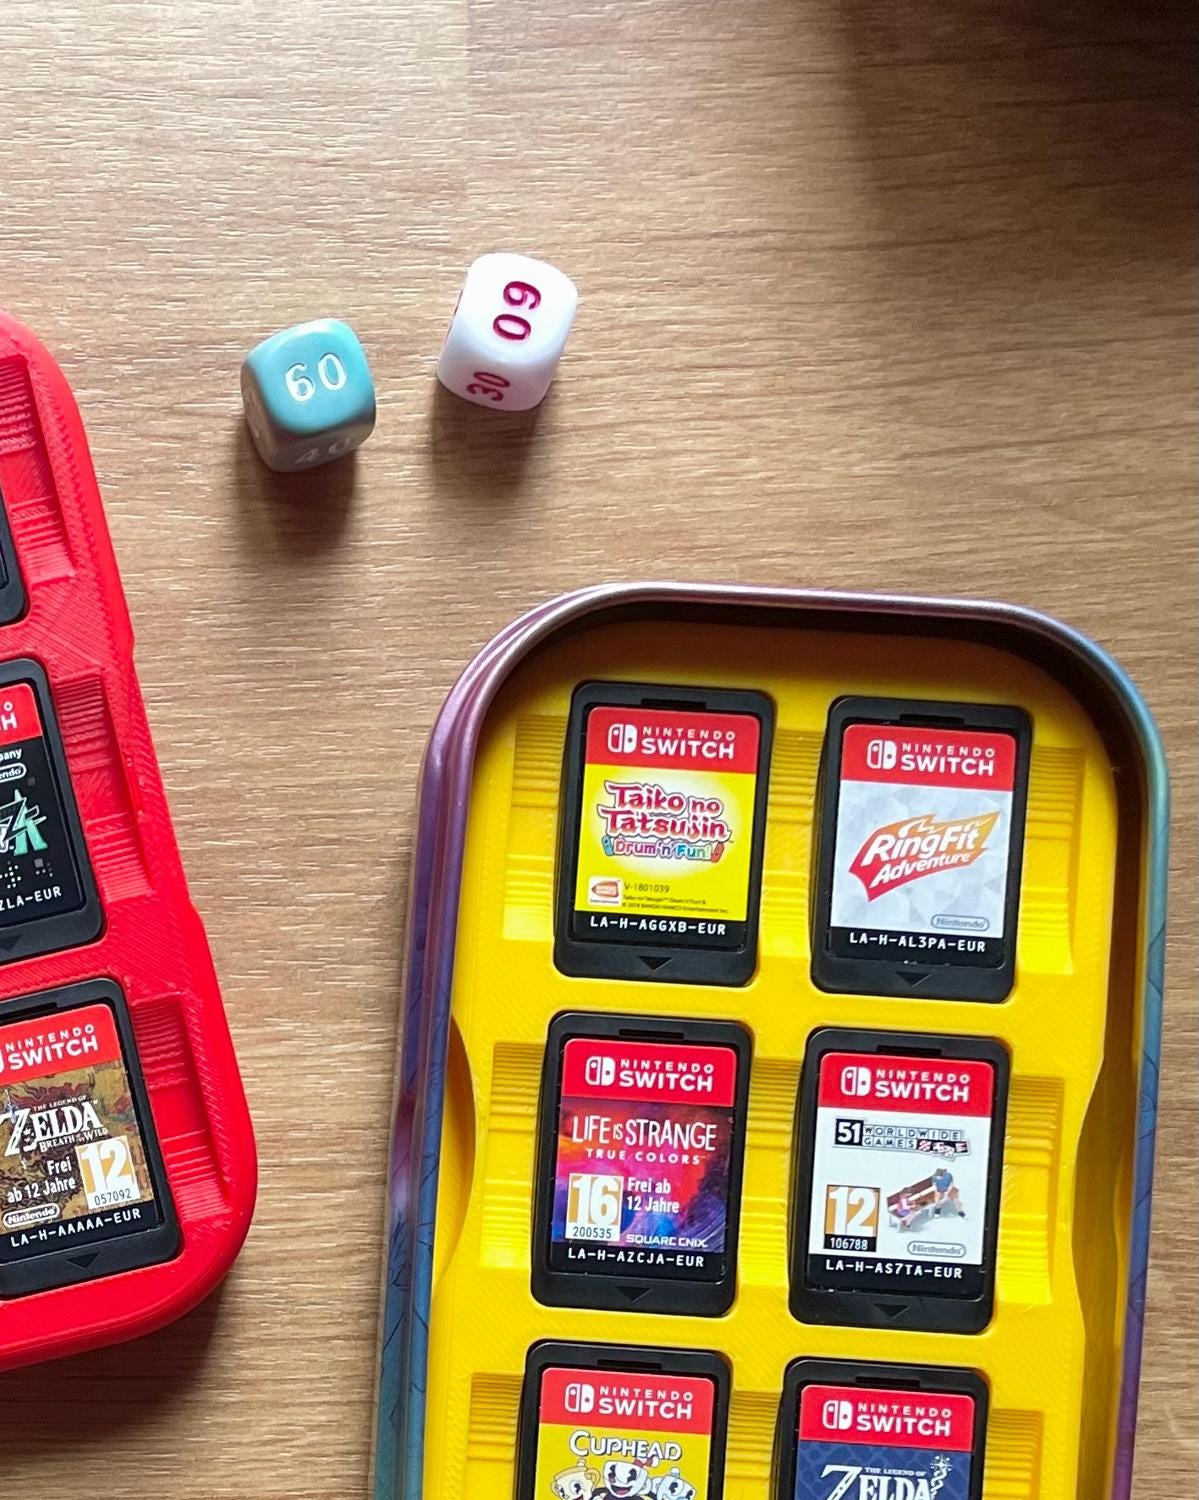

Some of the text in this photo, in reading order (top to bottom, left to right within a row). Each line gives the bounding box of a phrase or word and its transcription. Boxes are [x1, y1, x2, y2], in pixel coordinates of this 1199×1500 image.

[493, 281, 542, 342] 60
[284, 352, 348, 402] 60
[467, 371, 511, 401] 30
[643, 726, 736, 741] NINTENDO
[642, 738, 734, 759] SWITCH
[903, 743, 995, 758] NINTENDO
[901, 755, 994, 777] SWITCH
[606, 781, 721, 814] Taiko no
[599, 807, 729, 841] Tatsujin
[869, 852, 972, 888] Adventure
[624, 883, 670, 893] V-1801039
[590, 916, 726, 935] LA-H-AGGXB-EUR
[849, 931, 986, 952] LA-H-AL3PA-EUR
[6, 1024, 94, 1051] NINTENDO
[8, 1036, 98, 1069] SWITCH
[620, 1059, 714, 1073] NINTENDO
[876, 1069, 970, 1084] NINTENDO
[619, 1071, 712, 1092] SWITCH
[876, 1081, 968, 1102] SWITCH
[84, 1128, 108, 1141] WILD
[572, 1116, 717, 1150] LIFE IS STRANGE
[837, 1122, 961, 1144] 51 WORLDWIDE
[863, 1137, 915, 1148] GAMES
[47, 1156, 72, 1175] Frei
[586, 1148, 700, 1165] TRUE COLORS
[80, 1141, 133, 1194] 12
[7, 1176, 77, 1203] ab 12 Jahre
[627, 1177, 670, 1194] Frei ab
[94, 1188, 132, 1206] 057092
[572, 1176, 619, 1225] 16
[627, 1196, 679, 1213] 12 Jahre
[828, 1187, 877, 1237] 12
[11, 1208, 142, 1247] LA-H-AAAAA-EUR
[572, 1226, 612, 1238] 200535
[830, 1238, 867, 1251] 106788
[568, 1248, 704, 1267] LA-H-AZCJA-EUR
[826, 1259, 962, 1278] LA-H-AS7TA-EUR
[600, 1386, 693, 1401] NINTENDO
[599, 1399, 692, 1420] SWITCH
[858, 1403, 952, 1418] NINTENDO
[857, 1415, 950, 1437] SWITCH
[569, 1430, 682, 1461] CUPHEAD
